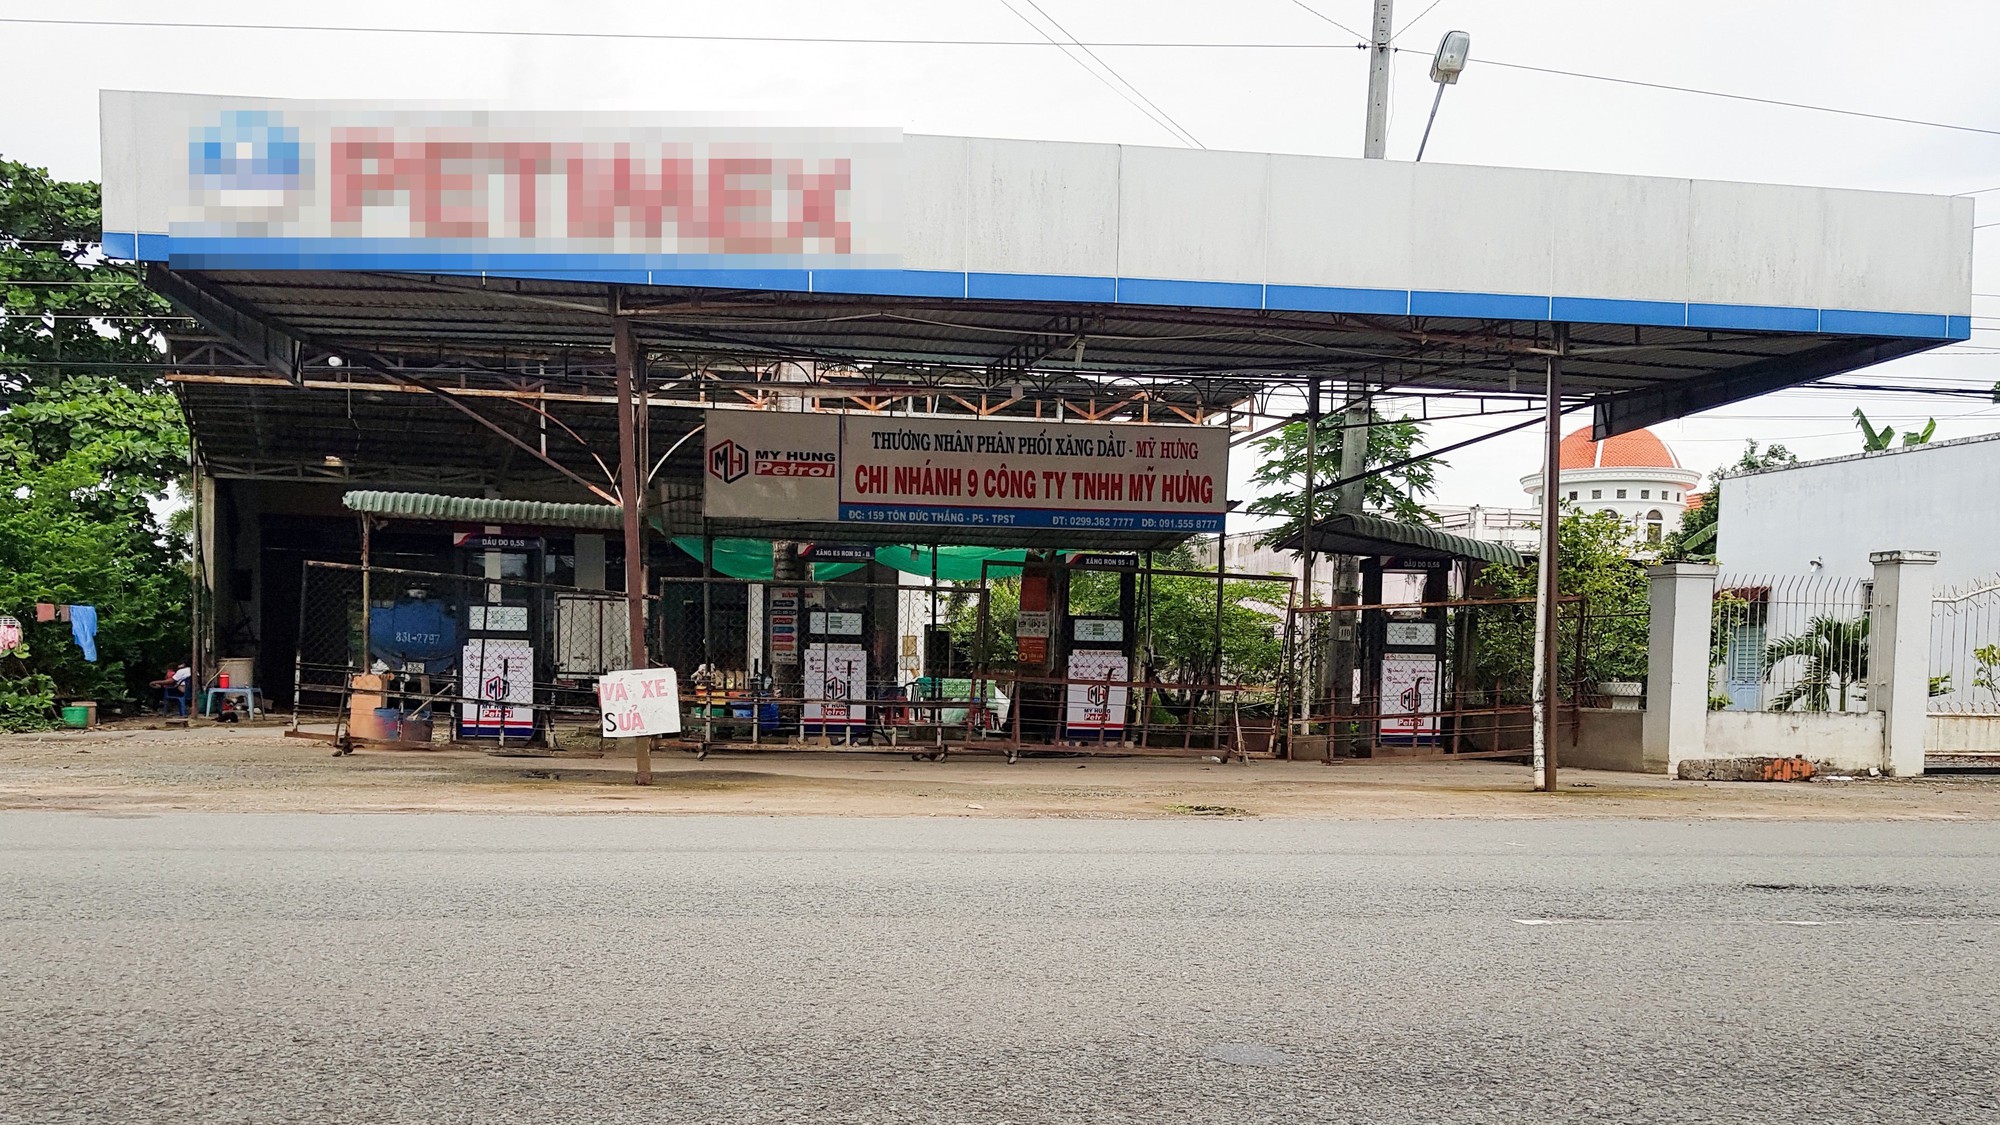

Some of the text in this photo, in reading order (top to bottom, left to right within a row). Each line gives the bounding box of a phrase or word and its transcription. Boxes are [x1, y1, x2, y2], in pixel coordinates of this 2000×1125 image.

[872, 428, 931, 451] THƯƠNG
[934, 429, 974, 453] NHÂN
[977, 431, 1015, 454] PHÂN
[1018, 429, 1052, 455] PHỐI
[1055, 434, 1094, 456] XĂNG
[1097, 430, 1126, 458] DẦU
[1136, 437, 1156, 459] MỸ
[1160, 438, 1199, 460] HƯNG
[755, 450, 836, 462] MY HUNG
[756, 461, 834, 477] Petrol
[855, 459, 1213, 504] CHI NHÁNH 9 CÔNG TY TNHH MỸ HƯNG
[867, 510, 884, 520] 159
[887, 509, 906, 521] TÔN
[908, 509, 929, 522] ĐỨC
[972, 513, 984, 523] P5
[992, 514, 1015, 525] TPST
[1112, 517, 1134, 527] 7777
[1159, 518, 1194, 528] 091.555
[1195, 519, 1218, 529] 8777
[602, 678, 668, 701] VÁ XE
[604, 704, 645, 732] SỬA
